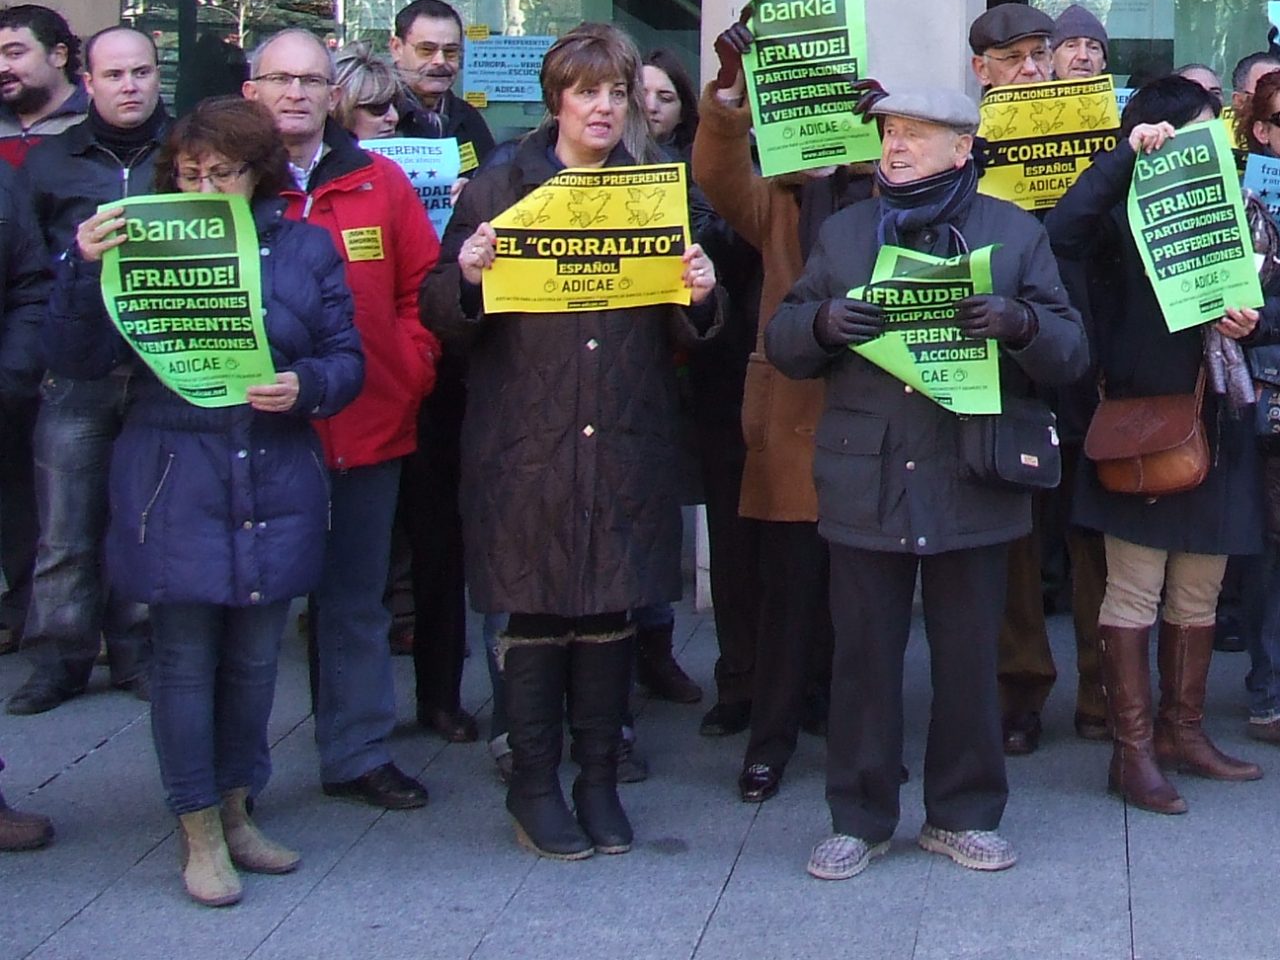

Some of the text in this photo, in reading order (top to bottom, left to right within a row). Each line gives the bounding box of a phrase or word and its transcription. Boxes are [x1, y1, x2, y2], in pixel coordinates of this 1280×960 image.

[760, 37, 845, 66] ¡FRAUDE!
[756, 62, 856, 86] PARTICIPACIONES
[759, 82, 858, 106] PREFERENTE
[762, 105, 812, 122] Y VENTA
[799, 120, 839, 137] ADICAE
[1025, 162, 1075, 176] ESPAÑOL
[1137, 144, 1210, 181] Bankia
[600, 171, 678, 185] PREFERENTES
[1145, 184, 1222, 224] ¡FRAUDE!
[126, 218, 225, 242] Bankia
[1145, 209, 1235, 242] PARTICIPACIONES
[496, 234, 682, 256] EL "CORRALITO"
[1152, 227, 1240, 262] PREFERENTES
[558, 260, 618, 274] ESPAÑOL
[1158, 247, 1243, 278] Y VENTA ACCIONES
[126, 265, 235, 291] ¡FRAUDE!
[562, 279, 614, 292] ADICAE
[1194, 271, 1219, 290] ADICAE
[117, 296, 247, 313] PARTICIPACIONES
[866, 288, 969, 305] ¡FRAUDE!
[123, 317, 253, 335] PREFERENTES
[189, 338, 255, 350] ACCIONES
[920, 347, 986, 362] ACCIONES
[169, 357, 221, 374] ADICAE
